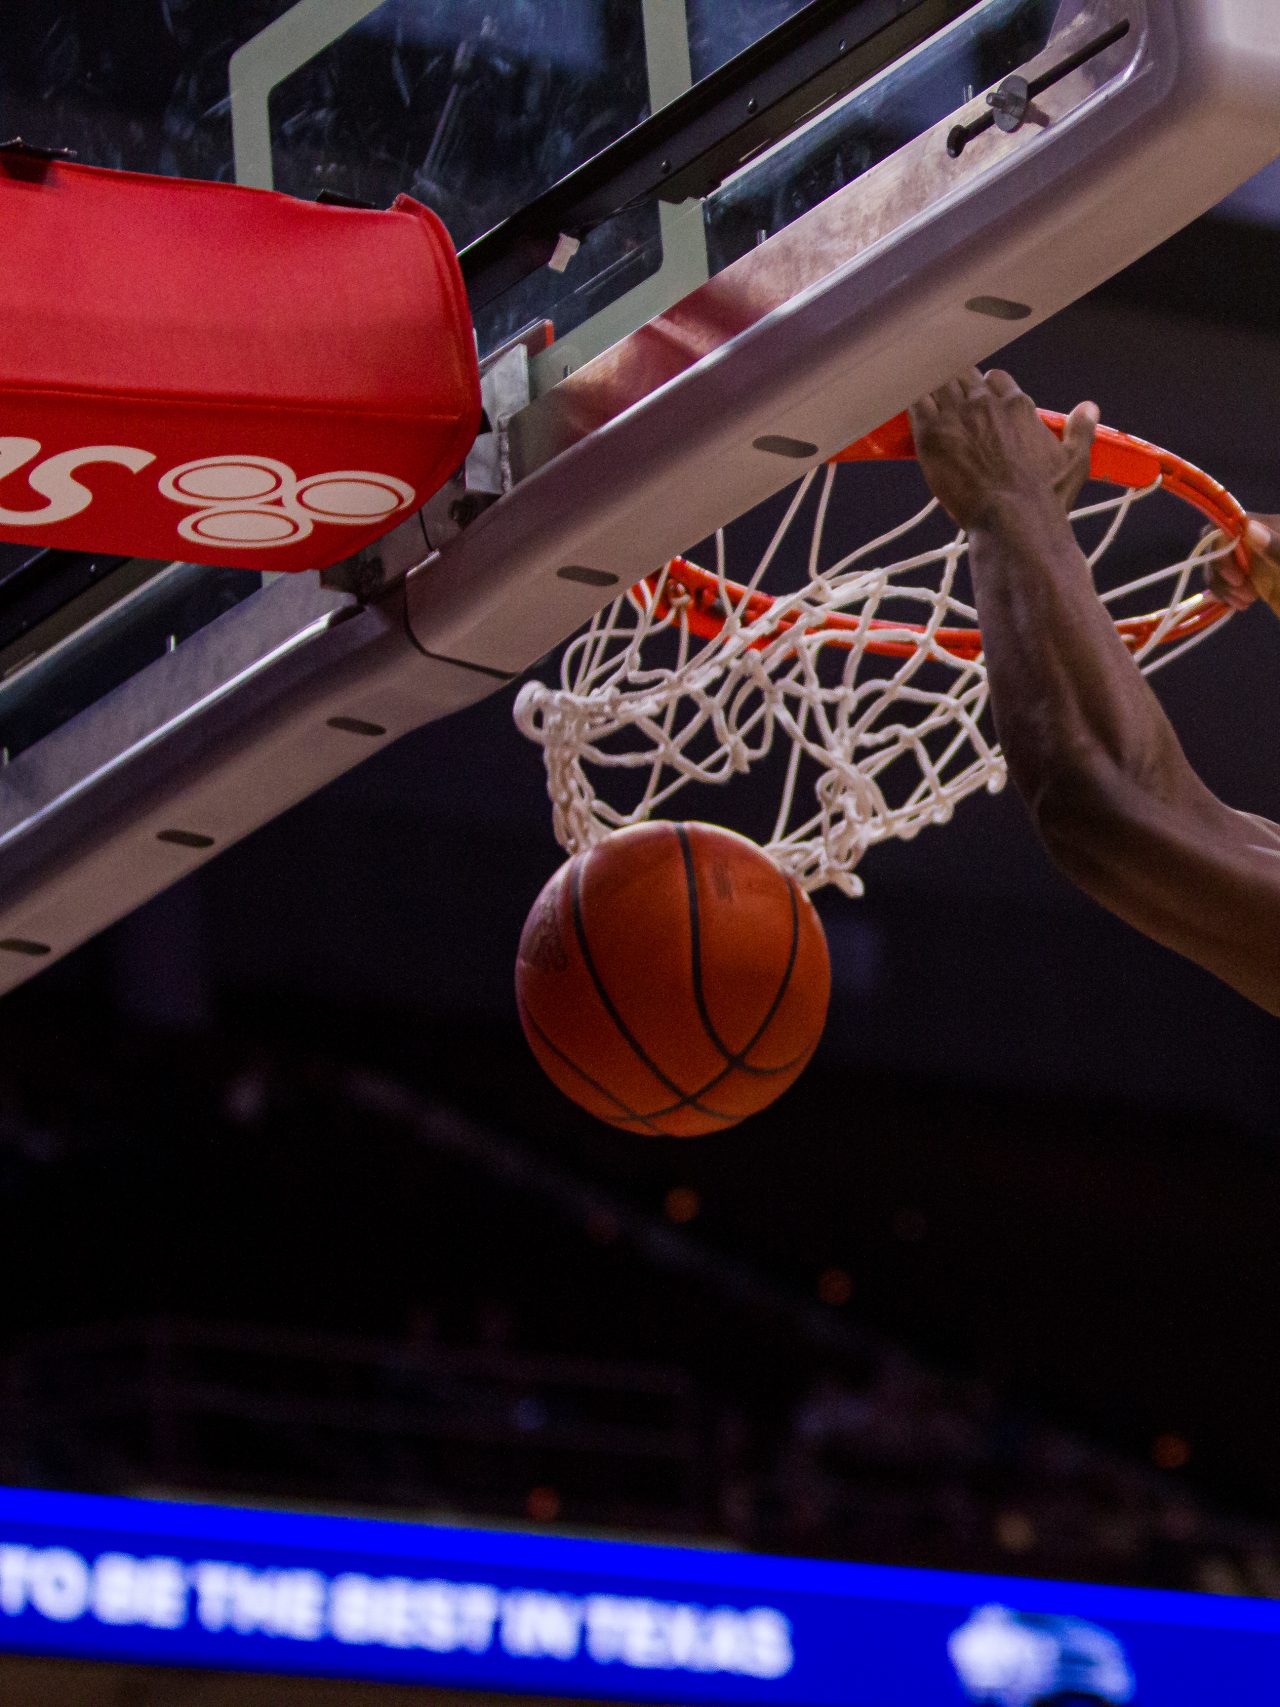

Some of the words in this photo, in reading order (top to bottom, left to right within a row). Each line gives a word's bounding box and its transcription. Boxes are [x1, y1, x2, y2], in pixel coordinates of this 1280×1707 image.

[0, 1541, 90, 1623] TO
[91, 1551, 187, 1630] BE
[190, 1559, 328, 1642] THE
[330, 1571, 497, 1656] BEST
[499, 1586, 582, 1662] IN
[583, 1592, 794, 1680] TEXAS
